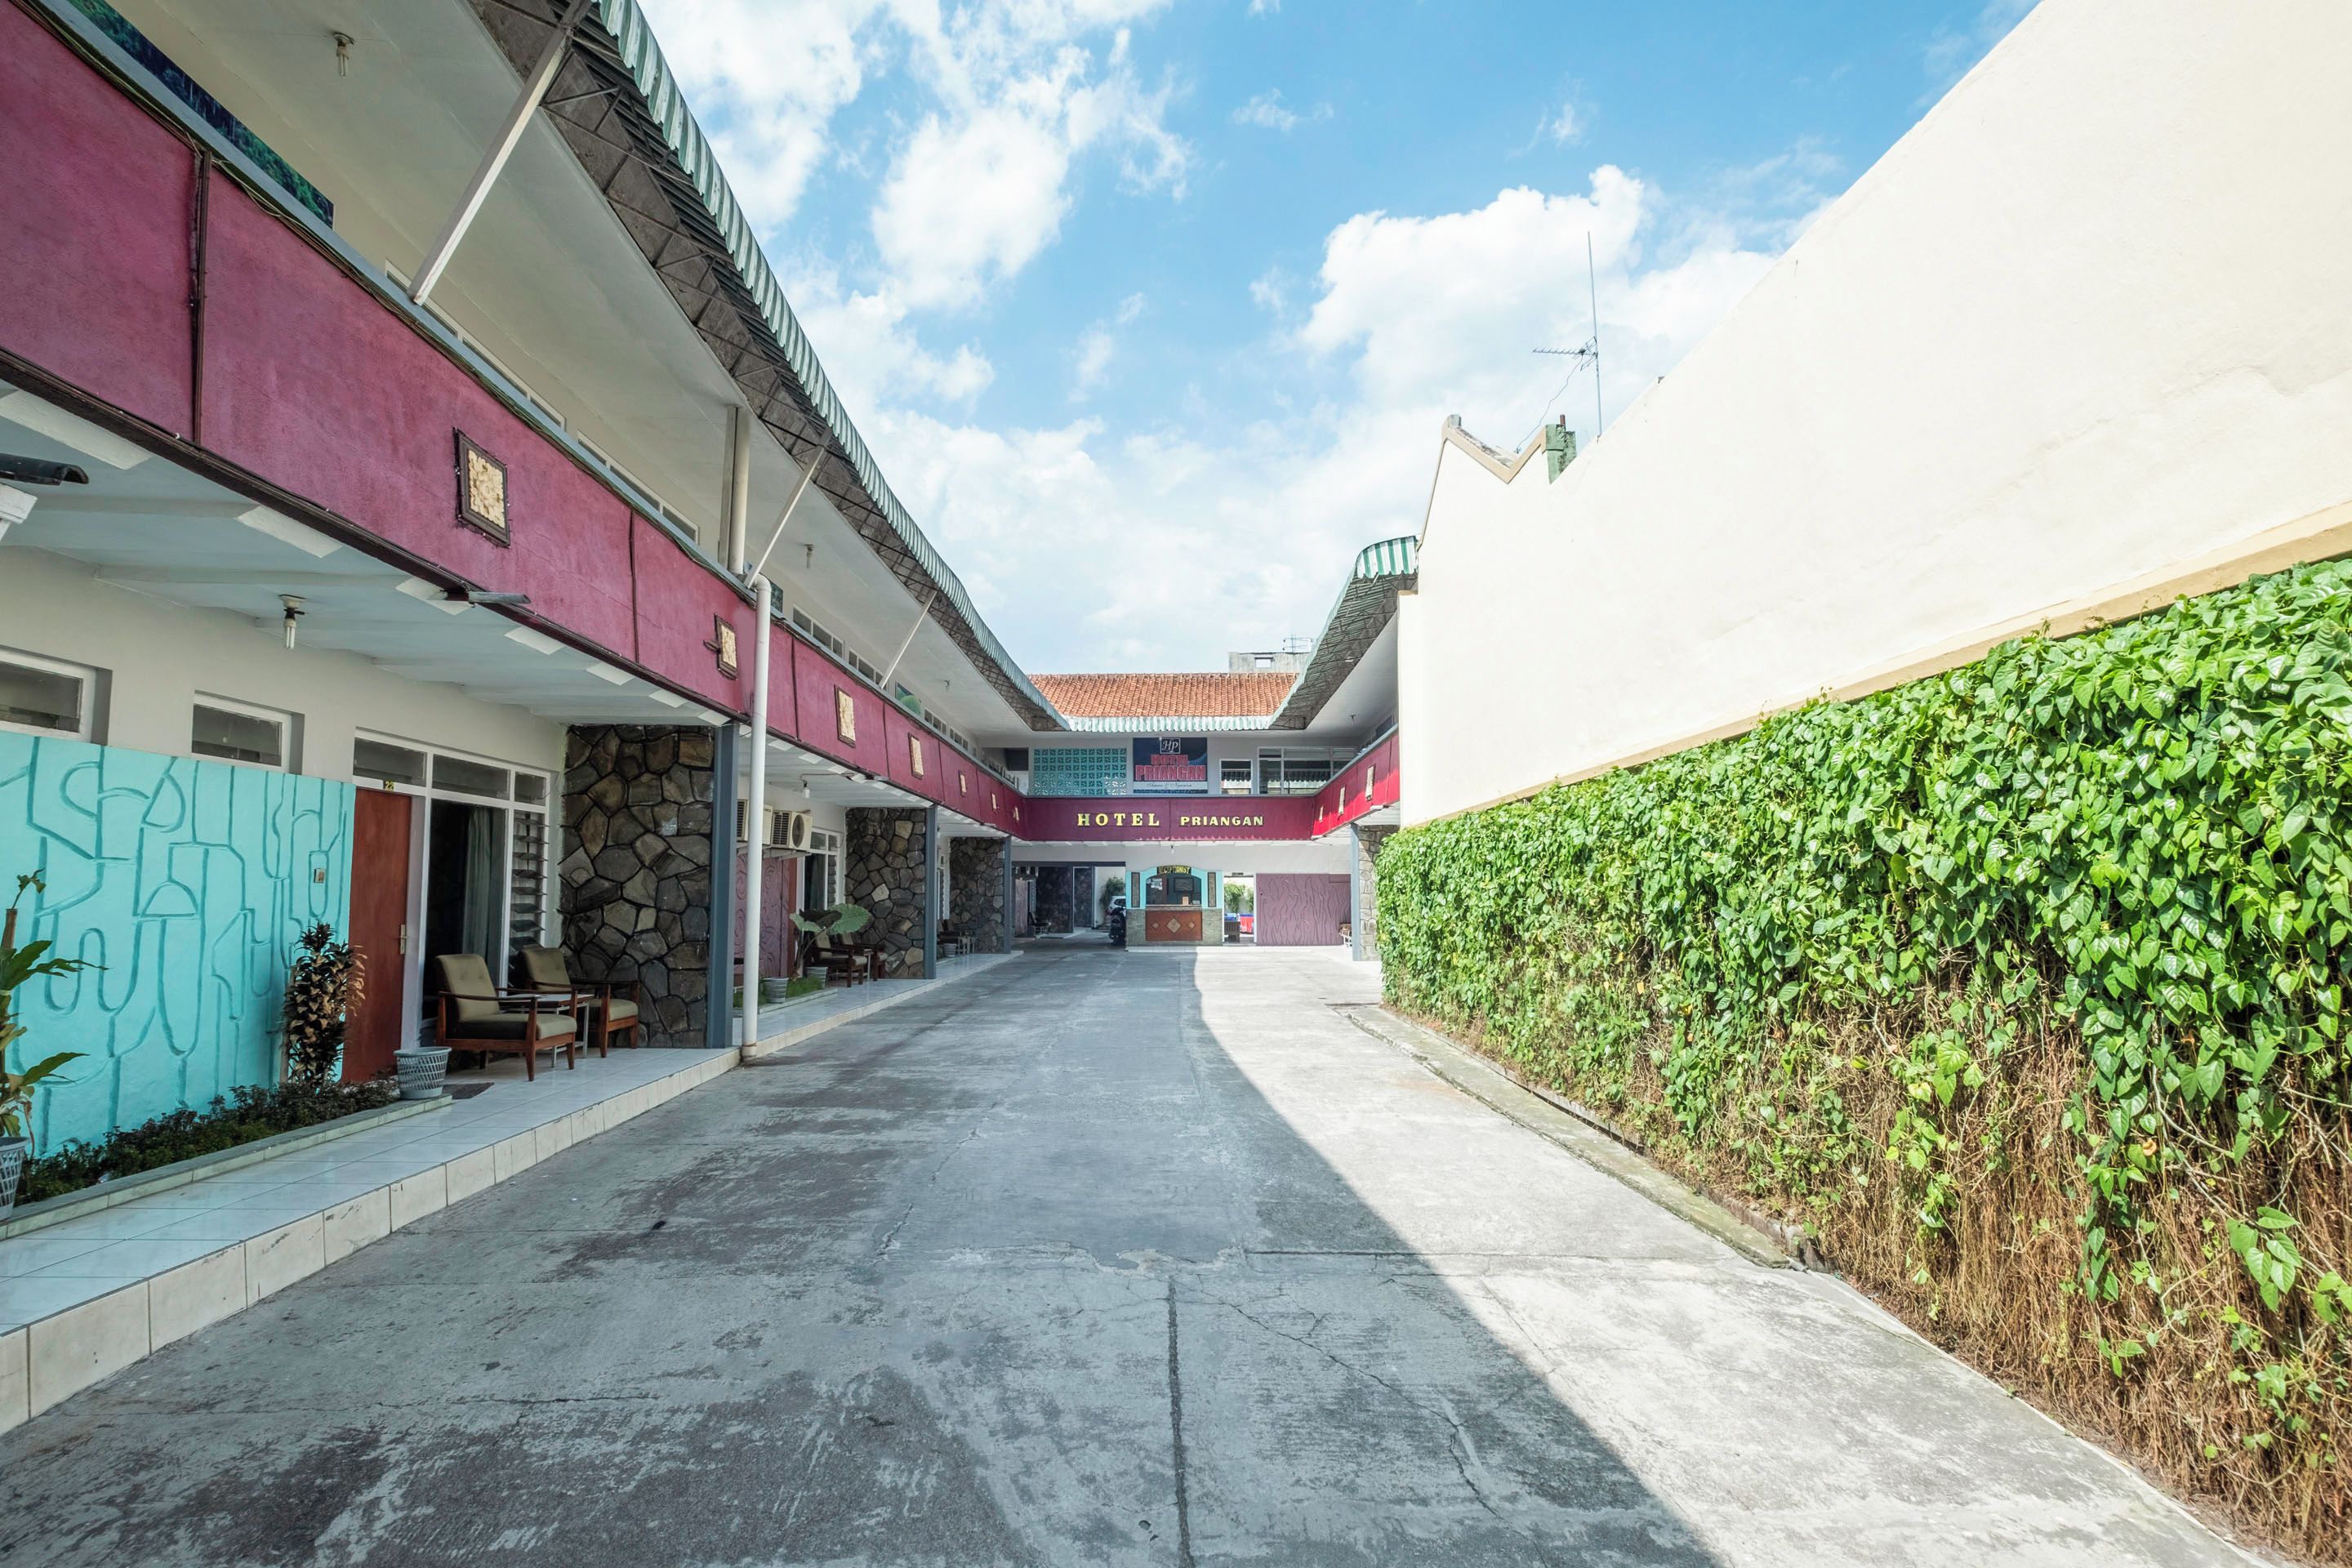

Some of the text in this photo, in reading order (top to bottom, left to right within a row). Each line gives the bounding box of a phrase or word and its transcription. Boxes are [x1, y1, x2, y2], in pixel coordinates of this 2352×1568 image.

[1151, 755, 1188, 765] HOTEL
[1136, 765, 1206, 781] PRIANGAN
[1077, 813, 1263, 826] HOTEL PRIANGAN
[1159, 866, 1190, 875] RECEPTIONIST
